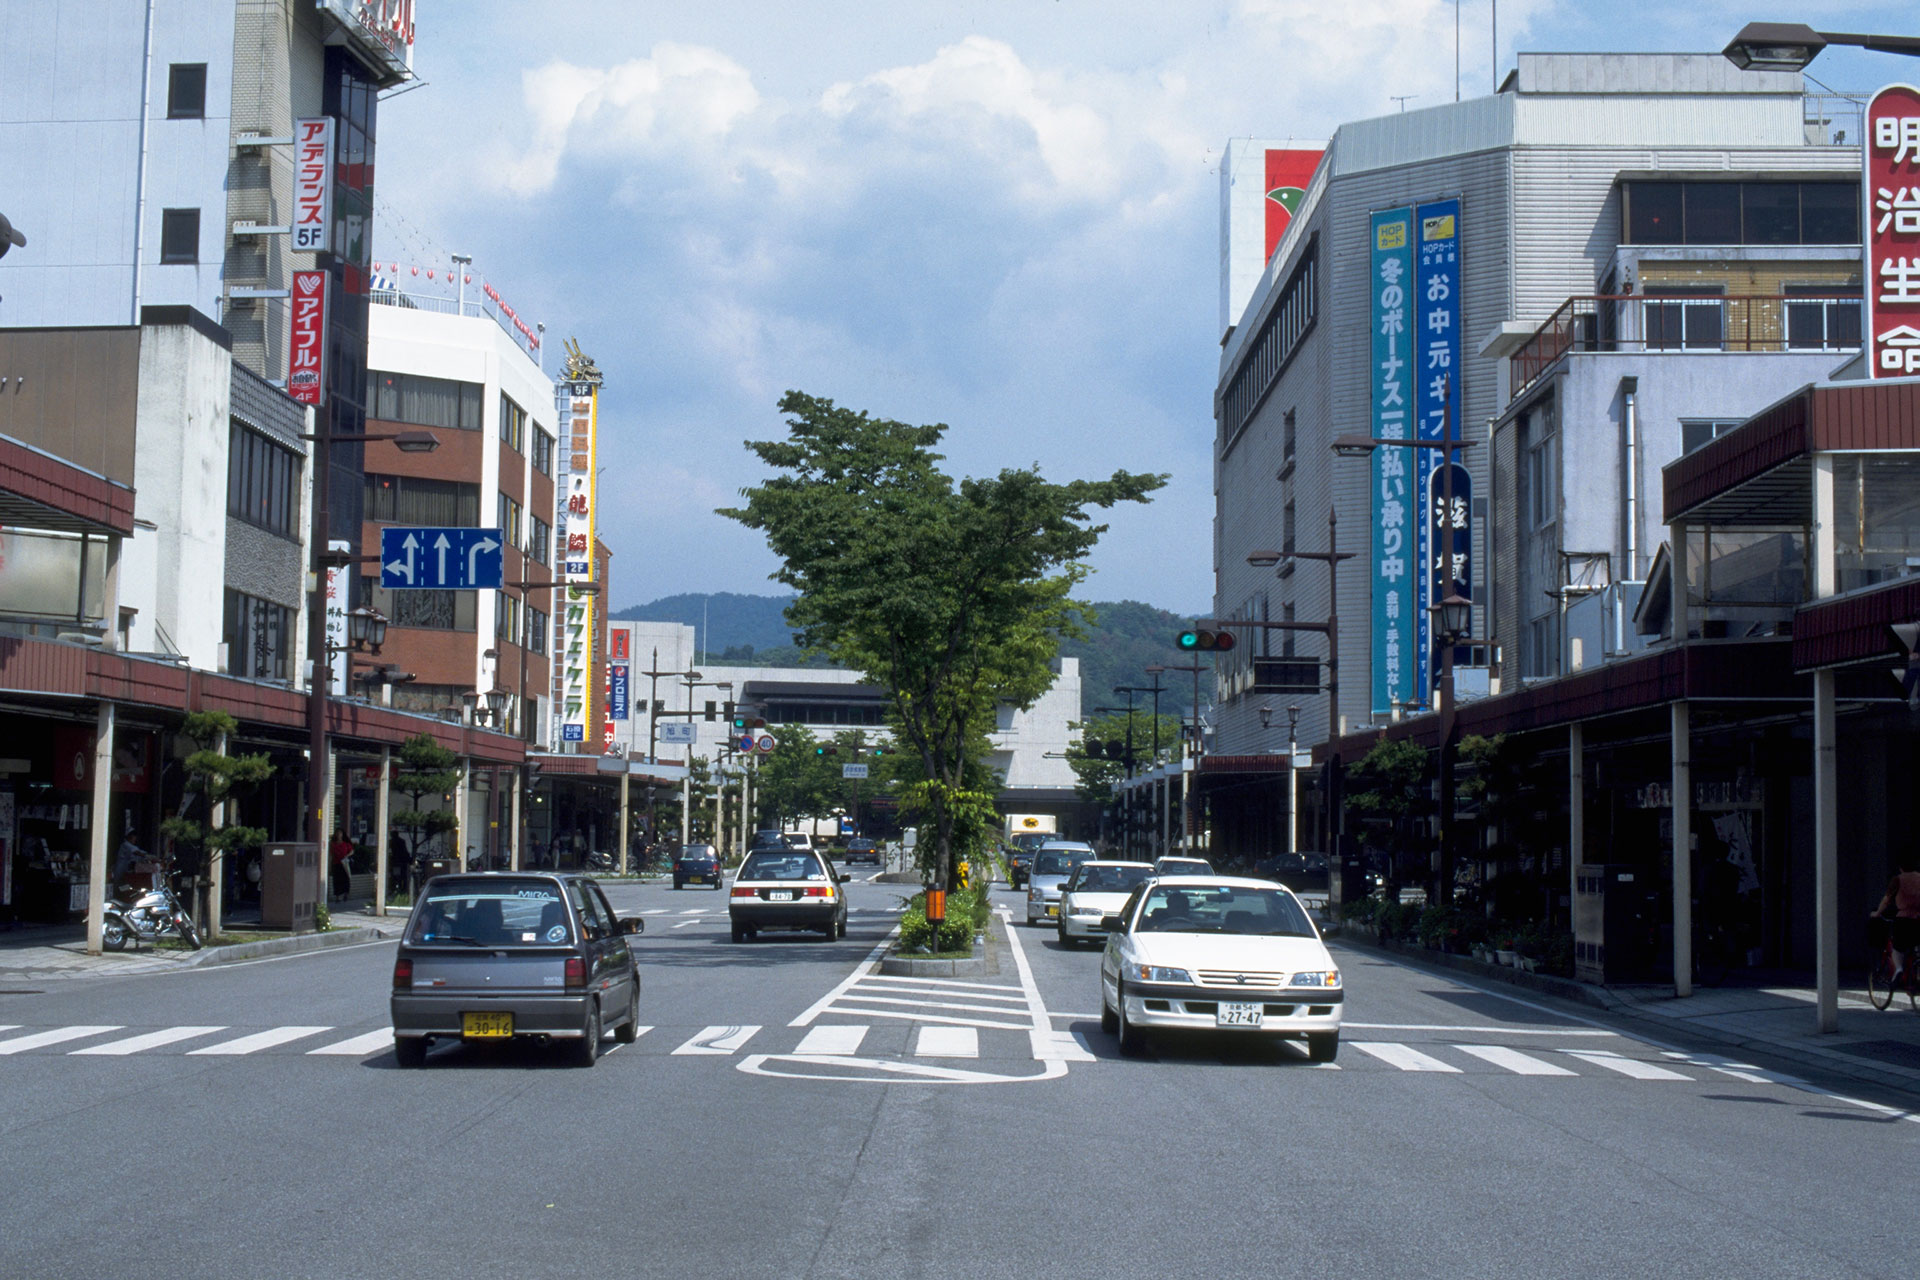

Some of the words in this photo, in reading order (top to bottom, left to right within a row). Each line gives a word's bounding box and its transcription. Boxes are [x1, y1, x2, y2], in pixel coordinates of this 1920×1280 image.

[297, 122, 325, 225] アデランス
[297, 228, 322, 247] 5F
[1381, 225, 1403, 237] HOP
[1381, 236, 1402, 247] カード
[1422, 241, 1455, 255] HOPカード
[1875, 116, 1920, 374] 明治生命
[294, 297, 320, 368] アイフル
[296, 392, 313, 401] 4F
[575, 386, 588, 395] 5F
[1381, 257, 1404, 583] 冬のボーナス一括払い承り中
[570, 563, 584, 573] 2F
[566, 605, 585, 718] カフェ・ケニア
[615, 677, 625, 711] プロミス
[666, 727, 691, 736] 旭町
[761, 740, 771, 748] 40
[518, 890, 552, 899] MIRA
[1228, 1011, 1261, 1024] 27-47
[474, 1022, 510, 1035] 30-16
